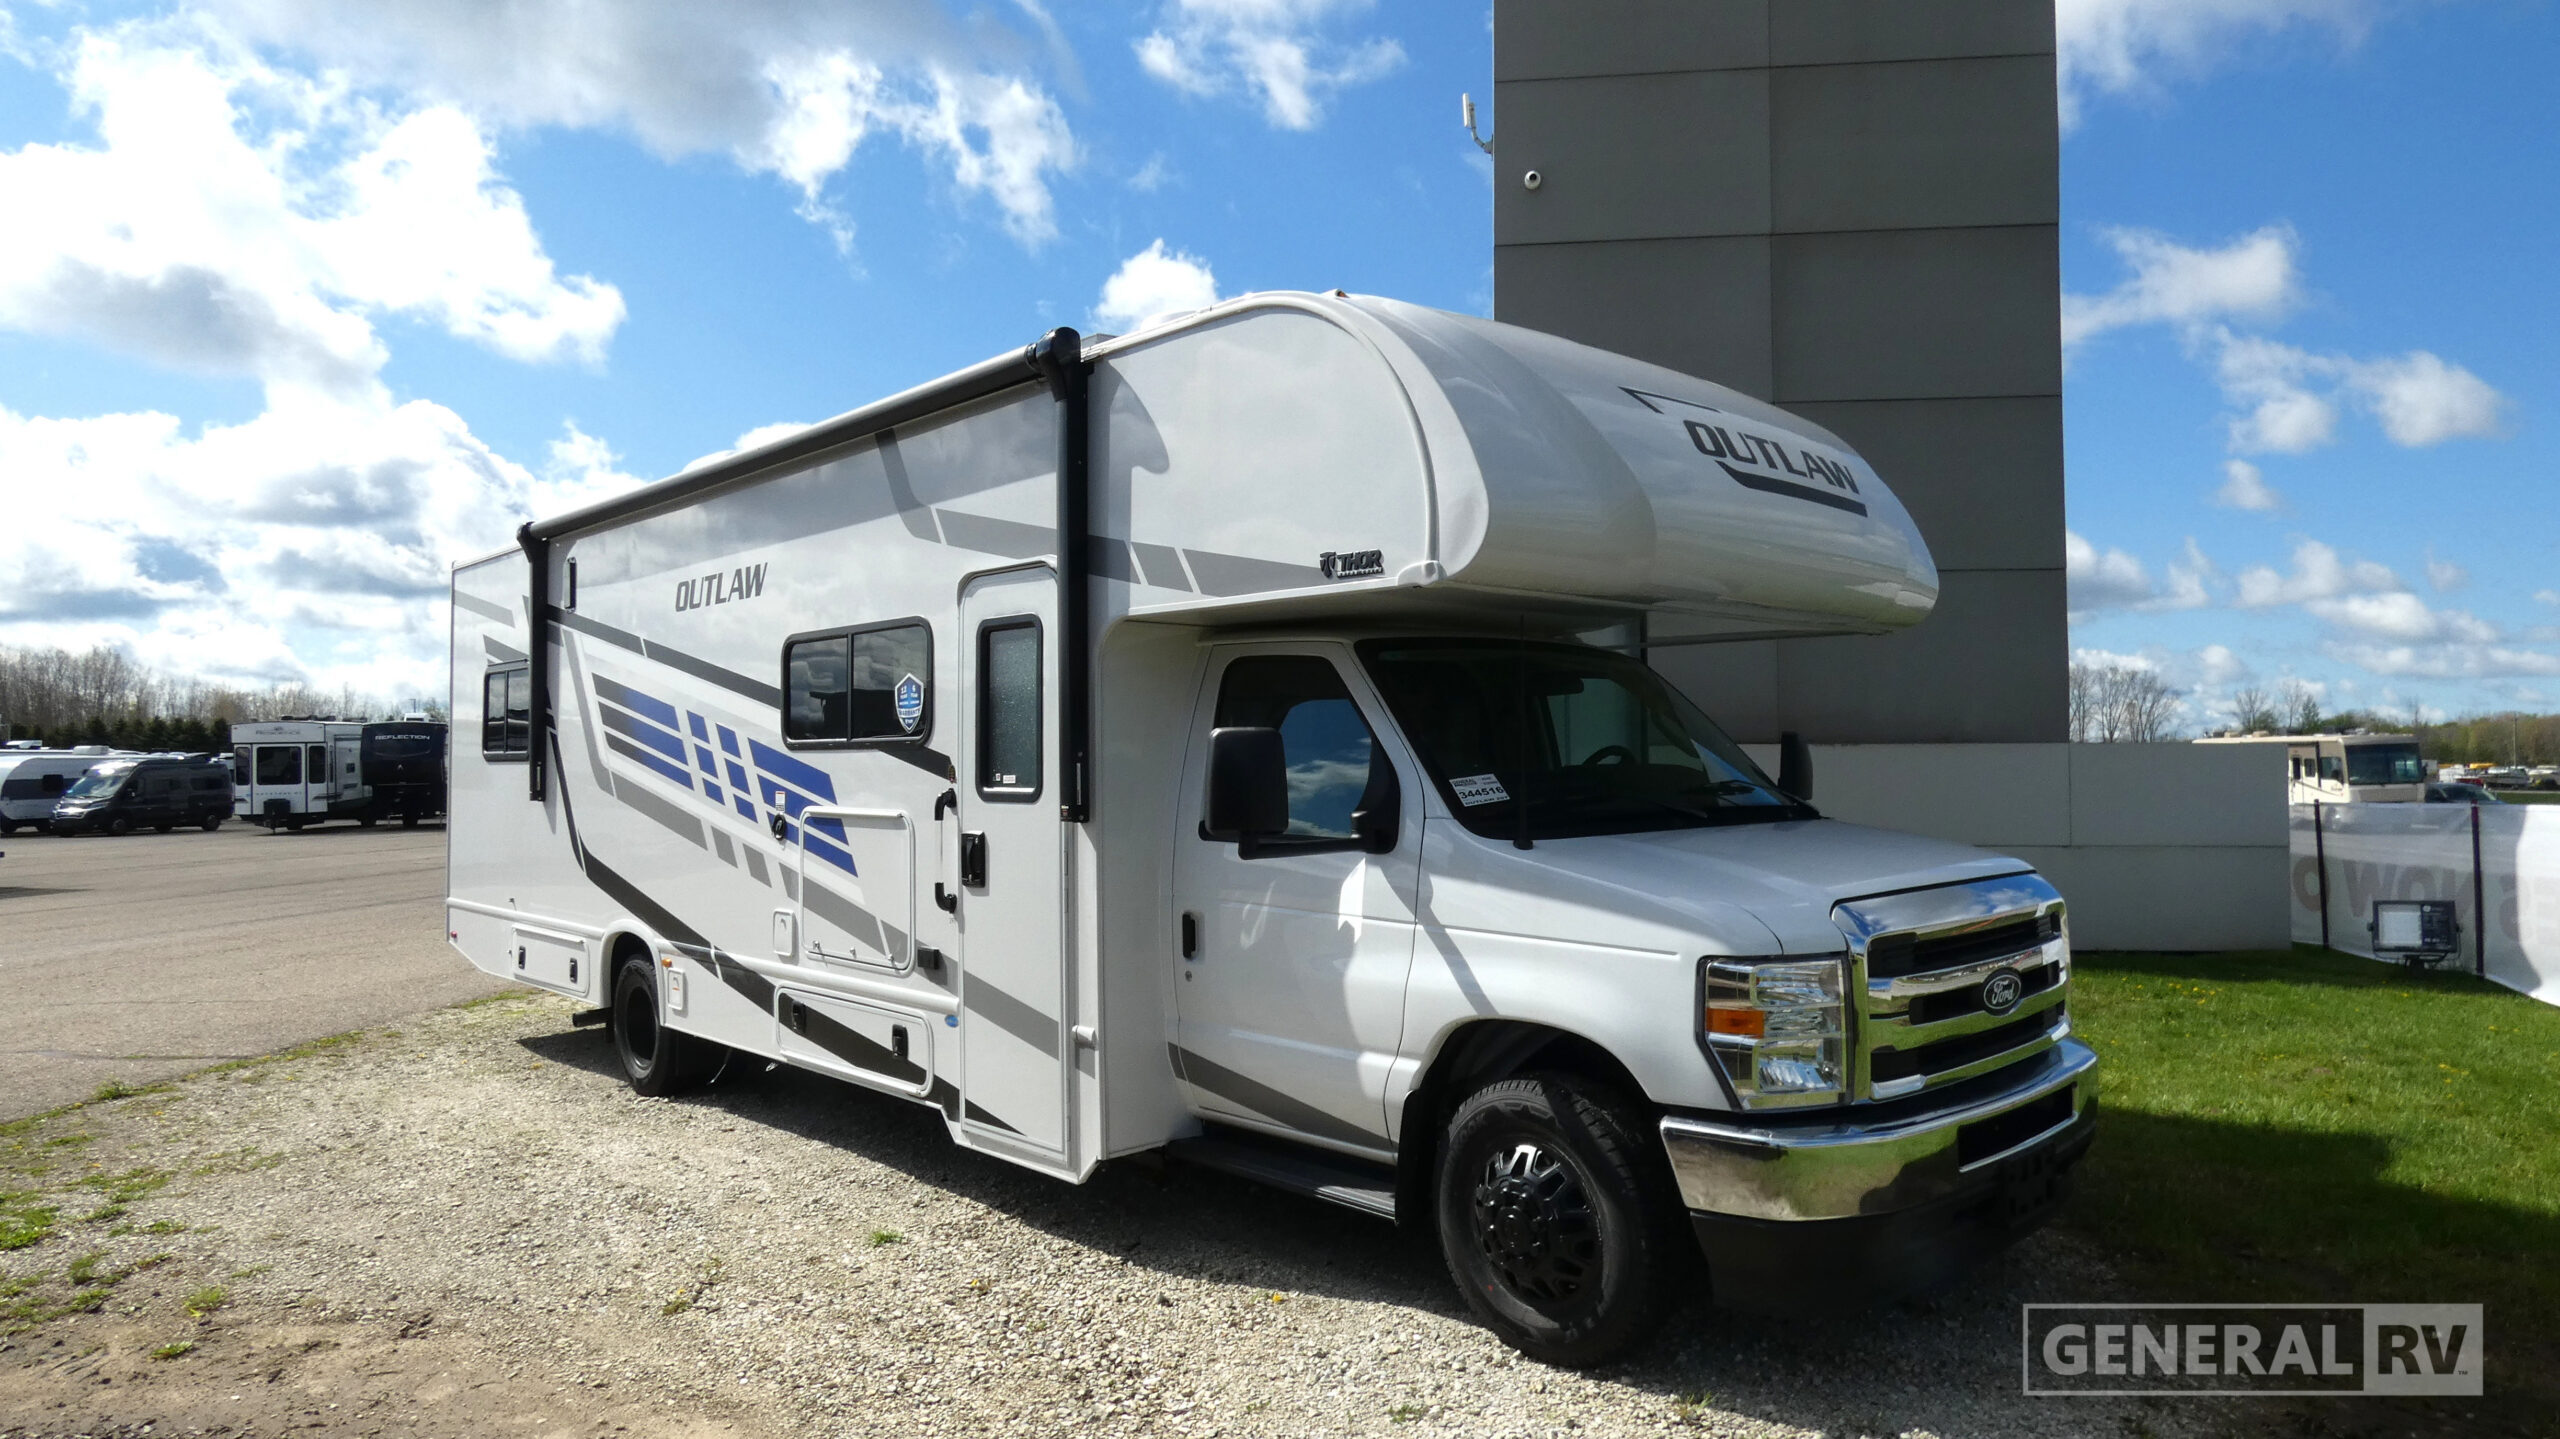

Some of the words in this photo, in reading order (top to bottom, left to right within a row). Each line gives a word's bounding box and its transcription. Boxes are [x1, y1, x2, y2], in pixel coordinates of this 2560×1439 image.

[1683, 420, 1860, 495] OUTLAW
[1337, 549, 1383, 572] THOR
[675, 562, 768, 612] OUTLAW
[1459, 786, 1504, 799] 344516
[1991, 979, 2015, 1005] Ford
